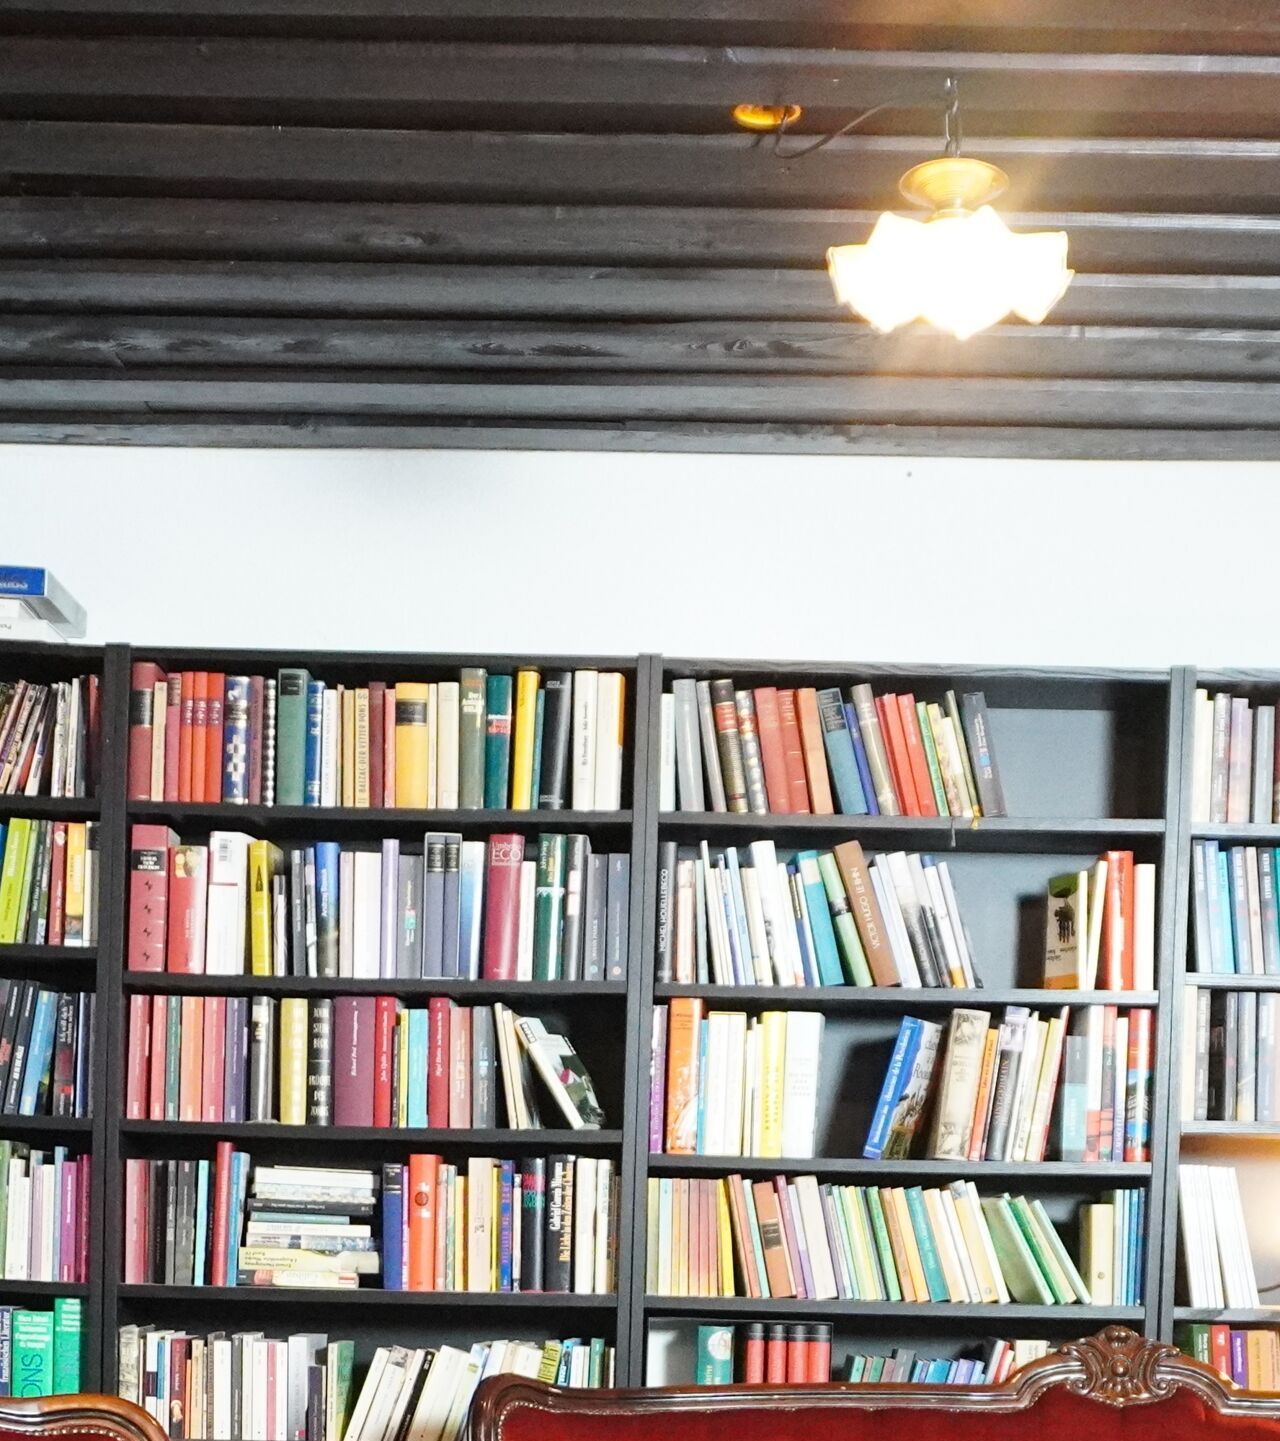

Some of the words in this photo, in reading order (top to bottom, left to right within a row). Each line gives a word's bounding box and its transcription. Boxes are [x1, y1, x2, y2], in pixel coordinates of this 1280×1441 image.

[492, 849, 522, 860] ECO
[660, 868, 669, 923] HOUELLEBECQ
[859, 896, 873, 921] HUGO
[659, 924, 667, 952] MICHEL
[866, 920, 881, 949] VICTOR
[559, 1196, 572, 1216] Zeiten
[549, 1207, 562, 1231] Gabriel
[559, 1232, 571, 1250] Liebe
[21, 1353, 43, 1398] ONS
